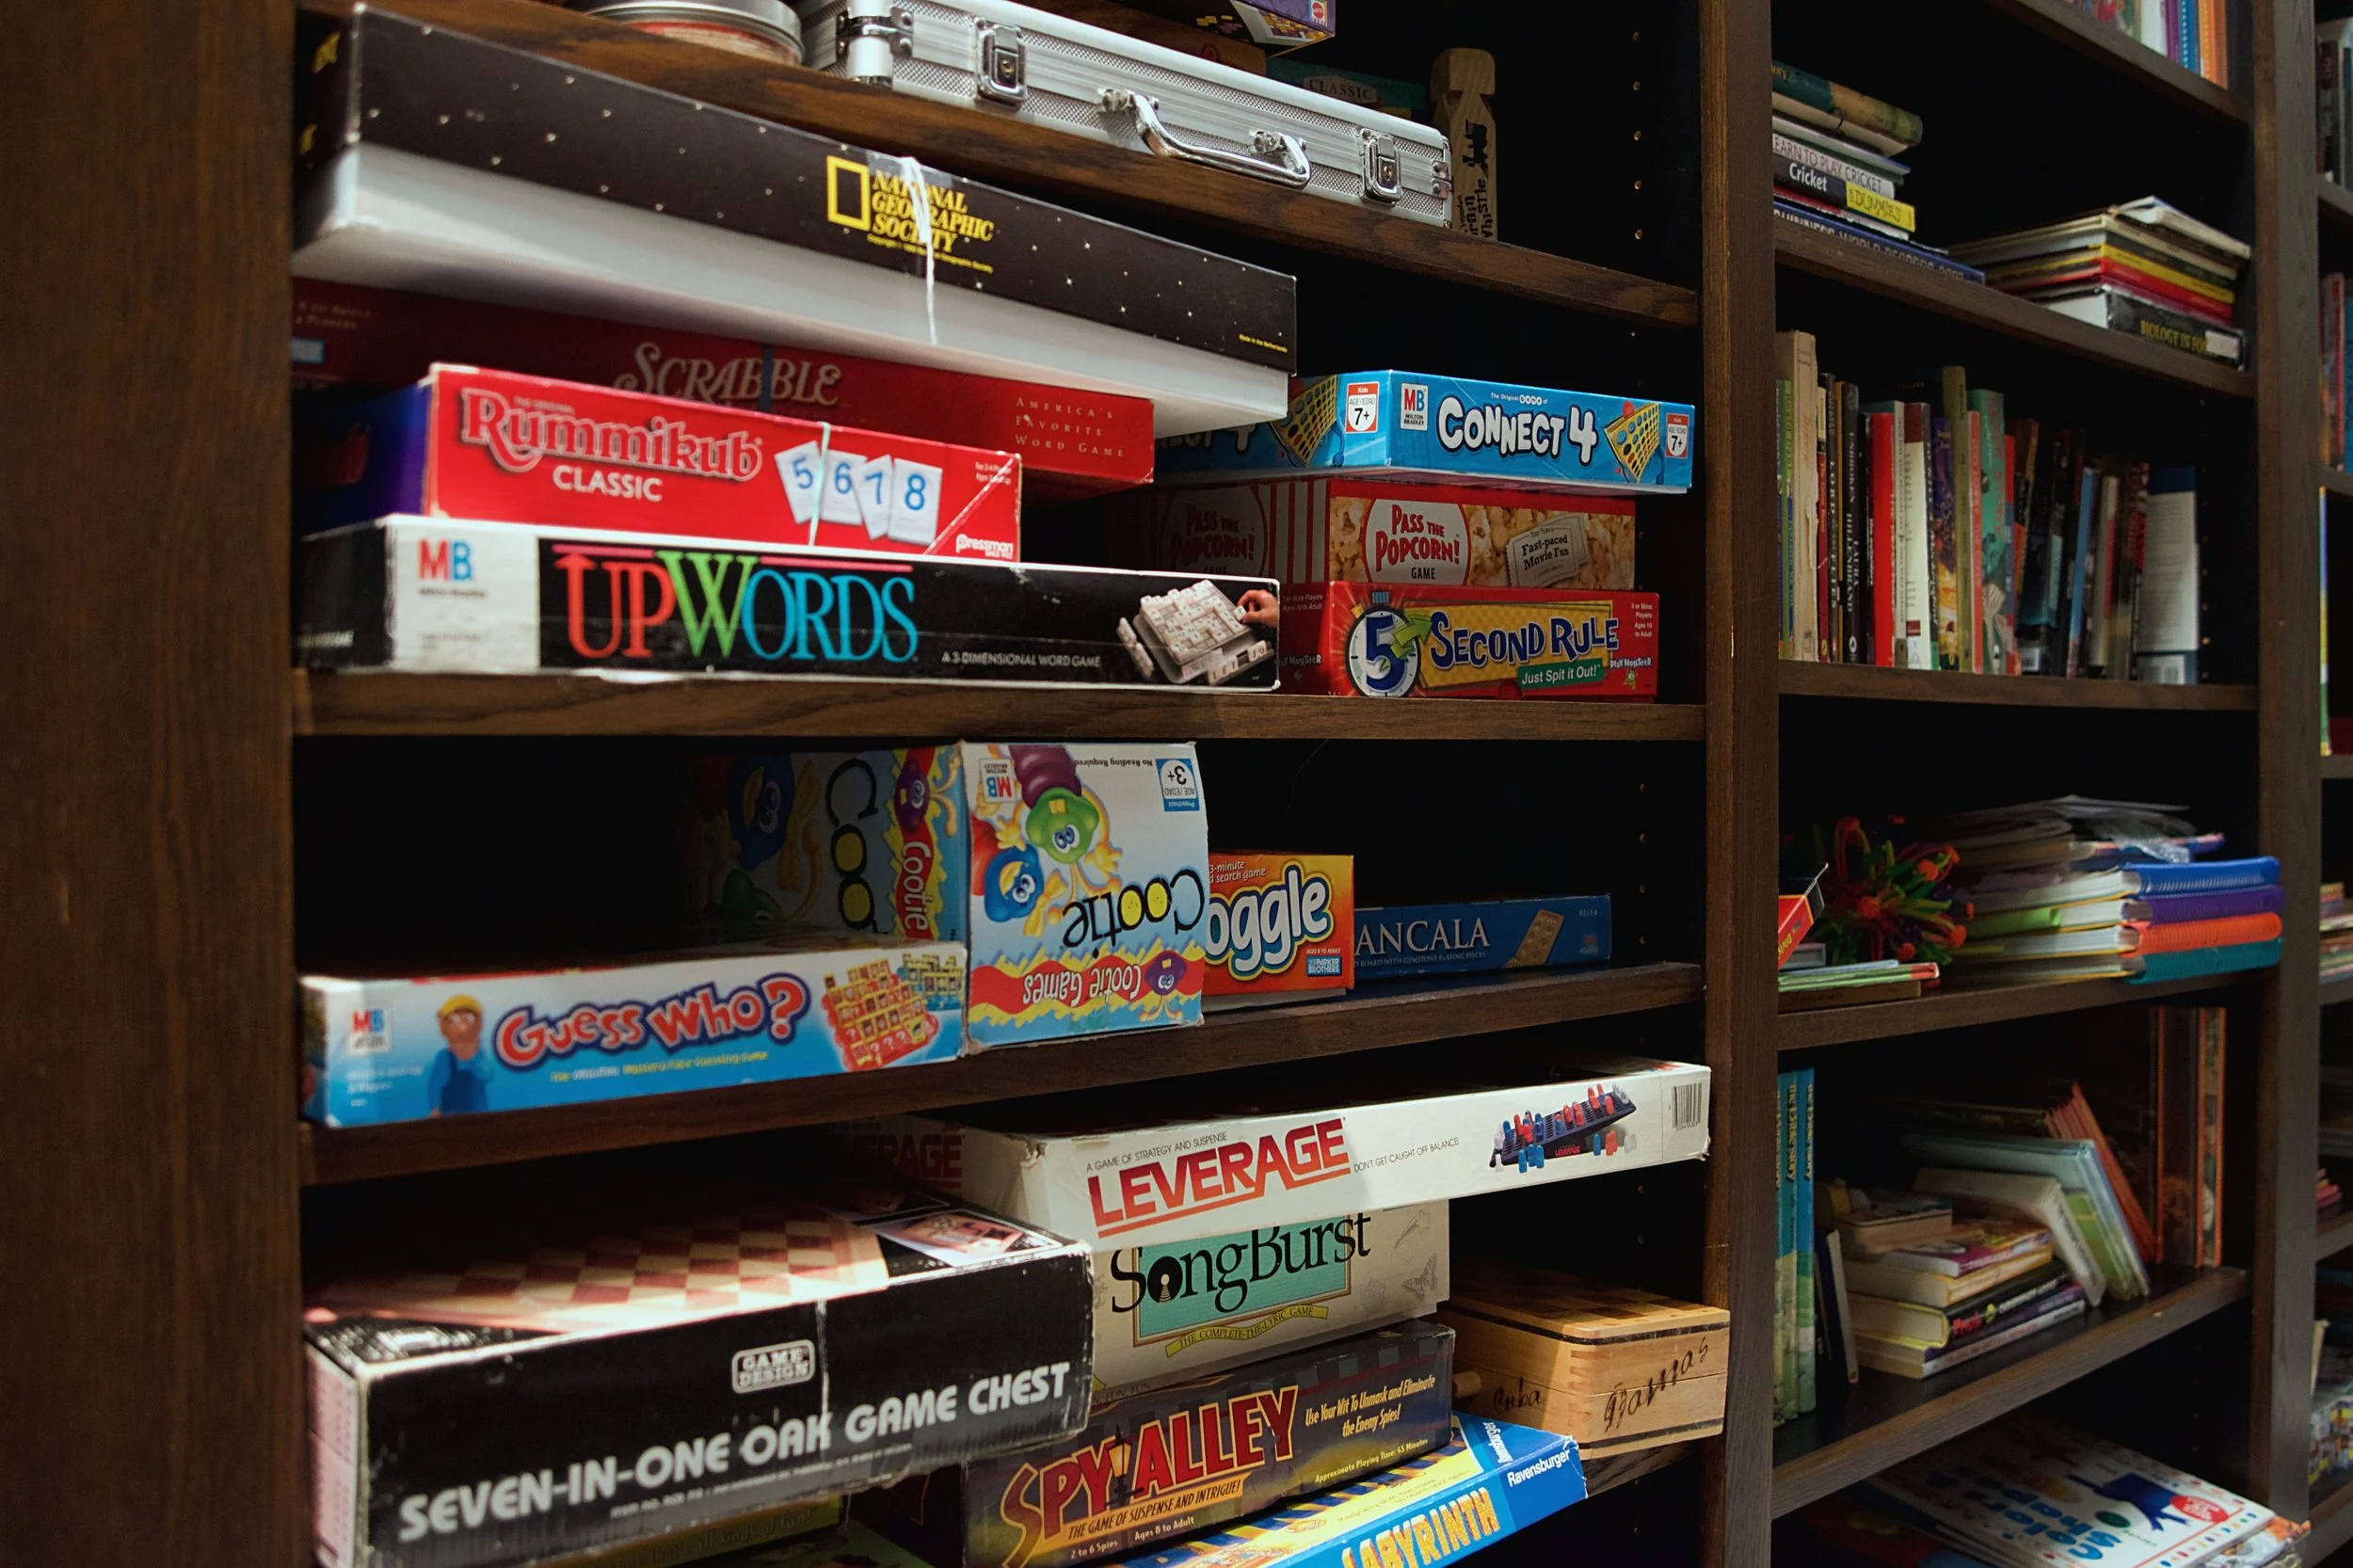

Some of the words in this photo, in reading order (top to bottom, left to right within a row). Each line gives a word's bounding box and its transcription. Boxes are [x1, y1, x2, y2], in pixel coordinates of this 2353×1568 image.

[1309, 79, 1371, 100] CLASSIC
[1789, 162, 1828, 193] Cricket
[1804, 148, 1818, 168] TO
[1820, 154, 1842, 177] PLAY
[1845, 166, 1882, 190] CRICKET
[1854, 190, 1902, 223] DUMMIES
[2140, 320, 2180, 348] BIOLOGY
[1016, 397, 1114, 420] AMERICA'S
[1353, 408, 1370, 425] 7+
[1403, 388, 1426, 412] MB
[460, 387, 763, 482] Rummikub
[1016, 415, 1104, 437] FAVORITE
[1437, 395, 1565, 456] CONNECT
[1569, 406, 1597, 464] 4
[1671, 436, 1683, 451] 7+
[1016, 435, 1066, 452] WORD
[1078, 443, 1126, 458] GAME
[552, 465, 664, 502] CLASSIC
[792, 456, 814, 489] 5
[835, 462, 852, 494] 6
[865, 472, 884, 505] 7
[904, 474, 926, 511] 8
[1828, 460, 1837, 514] LORD
[1848, 432, 1857, 504] UNBROKEN
[1392, 504, 1424, 536] PASS
[1426, 521, 1445, 537] THE
[418, 538, 473, 581] MB
[1375, 530, 1460, 573] POPCORN!
[1521, 535, 1568, 556] Fast-paced
[1524, 551, 1553, 571] Movie
[1554, 547, 1569, 557] Fun
[1846, 512, 1854, 613] HILLENBRAND
[1851, 540, 1861, 586] LAURA
[1411, 567, 1435, 580] GAME
[1829, 553, 1838, 610] FLIES
[552, 550, 919, 663] UPWORDS
[1363, 614, 1406, 691] 5
[1430, 611, 1545, 668] SECOND
[1550, 615, 1619, 661] RULE
[941, 651, 951, 664] A
[1038, 654, 1070, 666] WORD
[1071, 655, 1101, 667] GAME
[1521, 669, 1541, 684] Just
[1542, 666, 1566, 682] Spit
[1566, 666, 1575, 680] it
[1576, 664, 1597, 679] Out!
[1110, 758, 1142, 767] Reading
[1166, 765, 1186, 785] 3+
[986, 776, 1013, 798] MB
[1209, 860, 1245, 873] 3-minute
[1216, 869, 1241, 883] search
[1243, 868, 1266, 881] game
[903, 840, 935, 932] Cootie
[1063, 869, 1206, 959] Cootie
[1206, 869, 1329, 972] oggle
[1353, 917, 1491, 956] ANCALA
[1308, 965, 1340, 974] BROTHERS
[1315, 958, 1339, 967] PARKER
[1360, 958, 1383, 968] BOARD
[1384, 956, 1402, 966] WITH
[1403, 954, 1439, 966] GEMSTONE
[1439, 952, 1465, 963] PLAYING
[1465, 952, 1486, 960] PIECES
[1023, 969, 1083, 1008] Games
[1089, 965, 1142, 1002] Cootie
[1086, 1162, 1093, 1173] A
[1095, 1157, 1120, 1171] GAME
[1121, 1154, 1132, 1165] OF
[1134, 1144, 1172, 1161] STRATEGY
[1175, 1140, 1192, 1152] AND
[1193, 1131, 1227, 1147] SUSPENSE
[1353, 1160, 1374, 1173] DON'T
[1375, 1156, 1389, 1167] GET
[1388, 1149, 1416, 1162] CAUGHT
[1417, 1144, 1429, 1156] OFF
[1087, 1118, 1350, 1228] LEVERAGE
[1110, 1212, 1371, 1313] SongBurst
[1177, 1332, 1196, 1348] THE
[1199, 1309, 1288, 1338] COMPLETE-THE-LYRIC
[1289, 1305, 1314, 1317] GAME
[1305, 1407, 1319, 1427] Use
[1321, 1402, 1337, 1421] Your
[1337, 1397, 1350, 1416] Wit
[1350, 1394, 1359, 1412] To
[1359, 1385, 1388, 1409] Unmask
[1388, 1381, 1403, 1400] and
[1402, 1374, 1436, 1397] Eliminate
[1342, 1418, 1355, 1437] the
[1355, 1415, 1380, 1432] Enemy
[1379, 1403, 1401, 1430] Spies!
[398, 1432, 731, 1544] SEVEN-IN-ONE
[740, 1411, 831, 1467] OAK
[846, 1384, 957, 1444] GAME
[968, 1360, 1070, 1416] CHEST
[1315, 1464, 1355, 1483] Approximate
[1355, 1455, 1380, 1469] Playing
[1380, 1449, 1396, 1460] Time:
[1397, 1444, 1405, 1454] 45
[1405, 1438, 1429, 1451] Minutes
[1507, 1449, 1571, 1488] Ravensburger
[1000, 1448, 1117, 1568] SPY
[1131, 1385, 1298, 1500] ALLEY
[1068, 1525, 1086, 1541] THE
[1087, 1516, 1115, 1535] GAME
[1115, 1511, 1129, 1527] OF
[1129, 1499, 1175, 1522] SUSPENSE
[1175, 1494, 1194, 1511] AND
[1194, 1480, 1241, 1505] INTRIGUE!
[1134, 1529, 1154, 1543] Ages
[1155, 1526, 1160, 1535] 8
[1162, 1523, 1172, 1532] to
[1173, 1515, 1195, 1530] Adult
[1341, 1486, 1501, 1568] LABYRINTH
[1070, 1550, 1077, 1560] 2
[1078, 1547, 1087, 1557] to
[1089, 1544, 1096, 1554] 6
[1096, 1540, 1118, 1554] Spies
